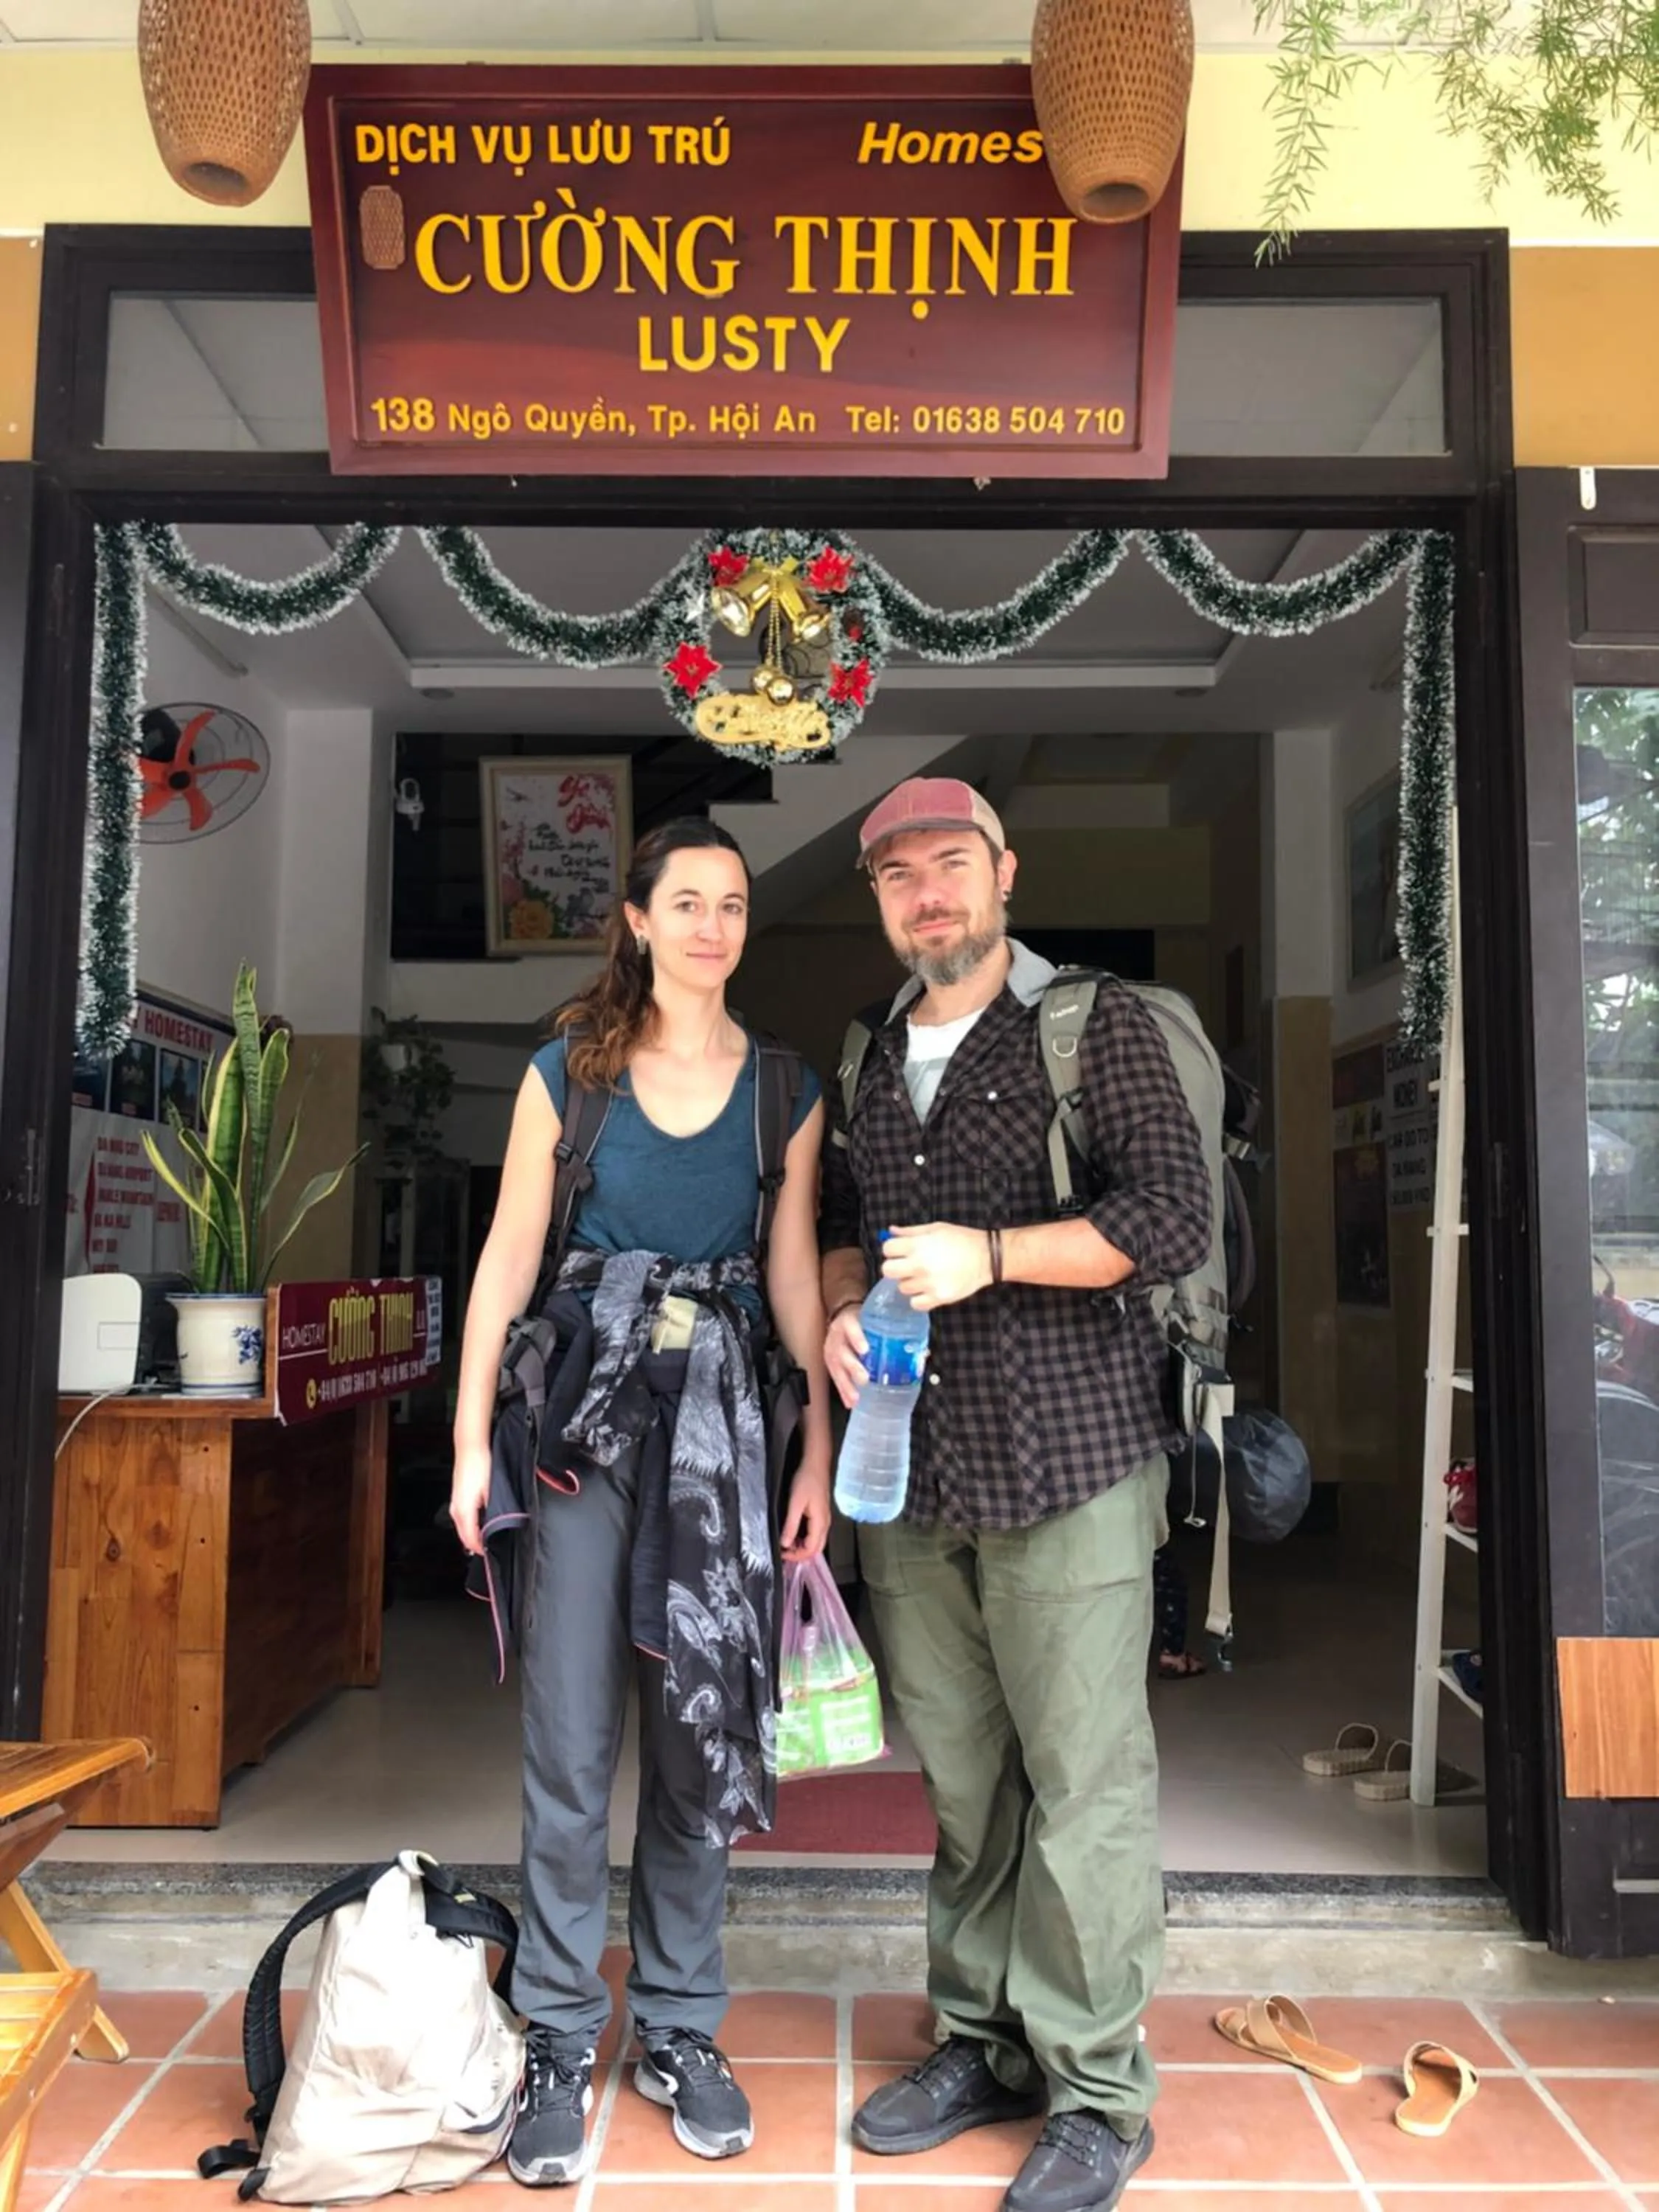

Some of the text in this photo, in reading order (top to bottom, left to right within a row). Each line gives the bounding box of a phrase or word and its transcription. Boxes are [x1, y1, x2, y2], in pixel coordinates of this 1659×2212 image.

[355, 116, 730, 176] DỊCH VỤ LƯU TRÚ
[858, 122, 1045, 164] Homes
[414, 187, 1077, 320] CƯỜNG THỊNH
[638, 313, 851, 373] LUSTY
[372, 396, 1126, 441] 138 Ngô Quyền, Tp. Hội An Tel: 01638 504 710
[144, 1009, 214, 1053] HOMESTAY
[282, 1322, 327, 1350] HOMESTAY
